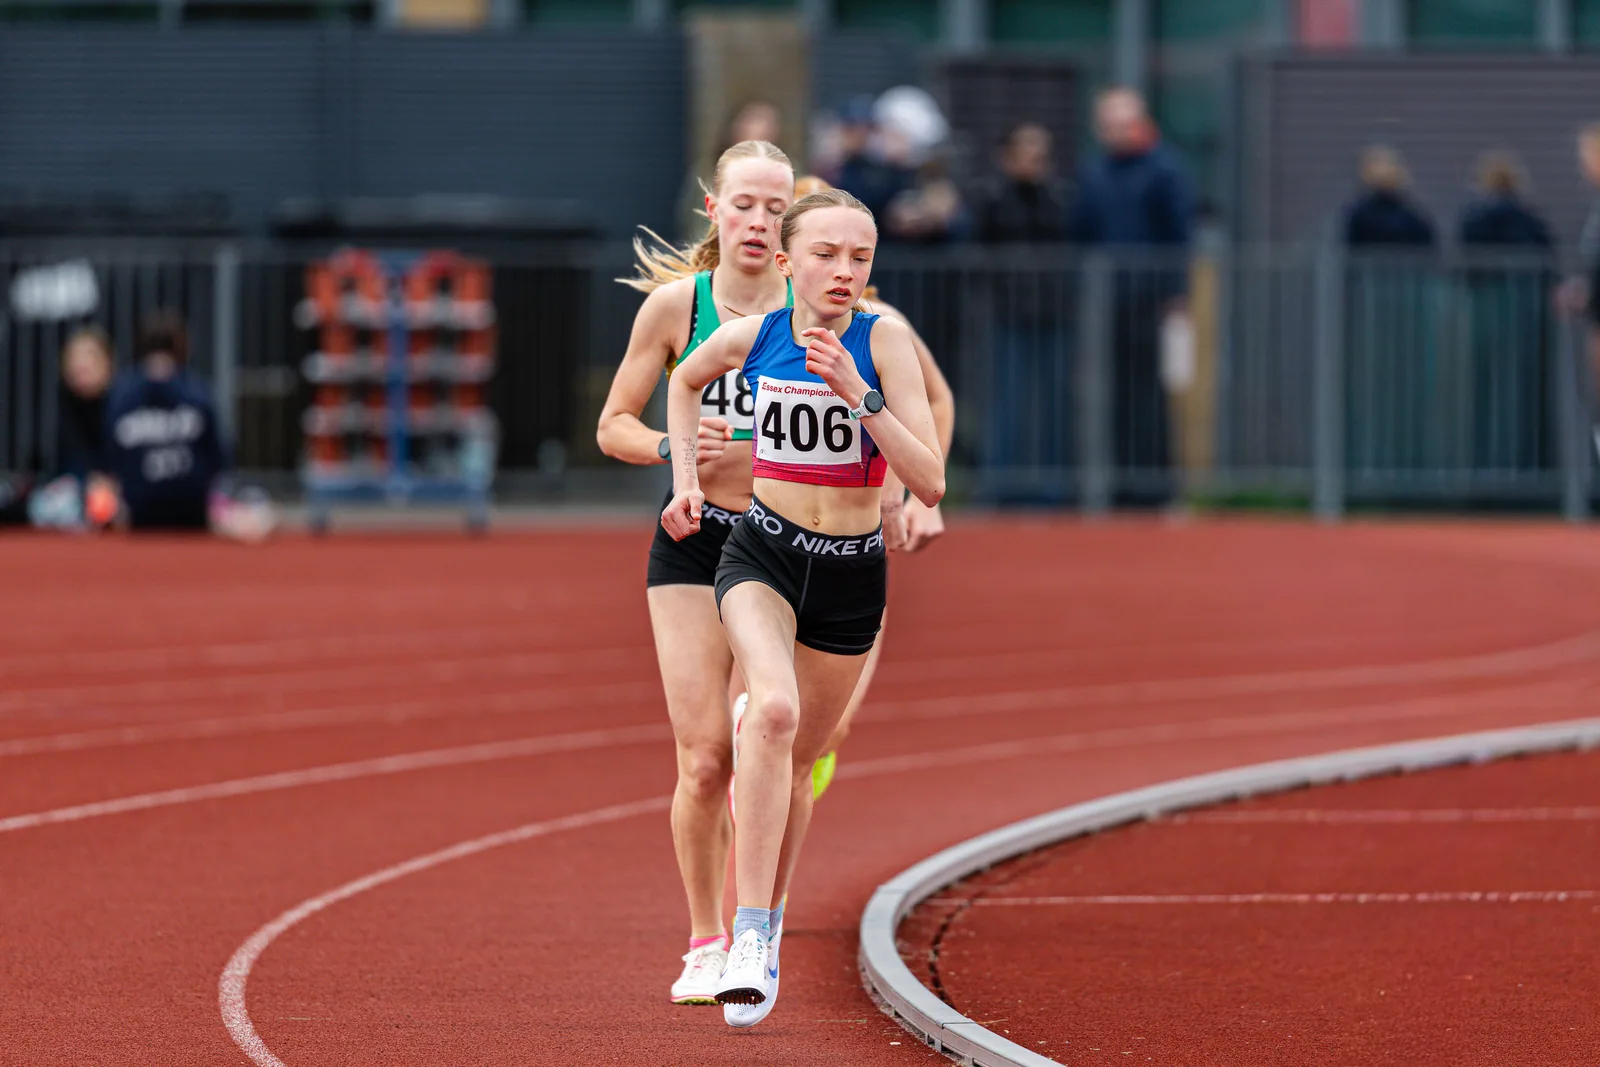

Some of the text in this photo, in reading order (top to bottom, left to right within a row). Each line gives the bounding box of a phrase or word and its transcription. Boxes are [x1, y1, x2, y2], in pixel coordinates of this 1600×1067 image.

[762, 382, 837, 397] Essex Champions
[761, 401, 853, 453] 406
[792, 532, 861, 556] NIKE
